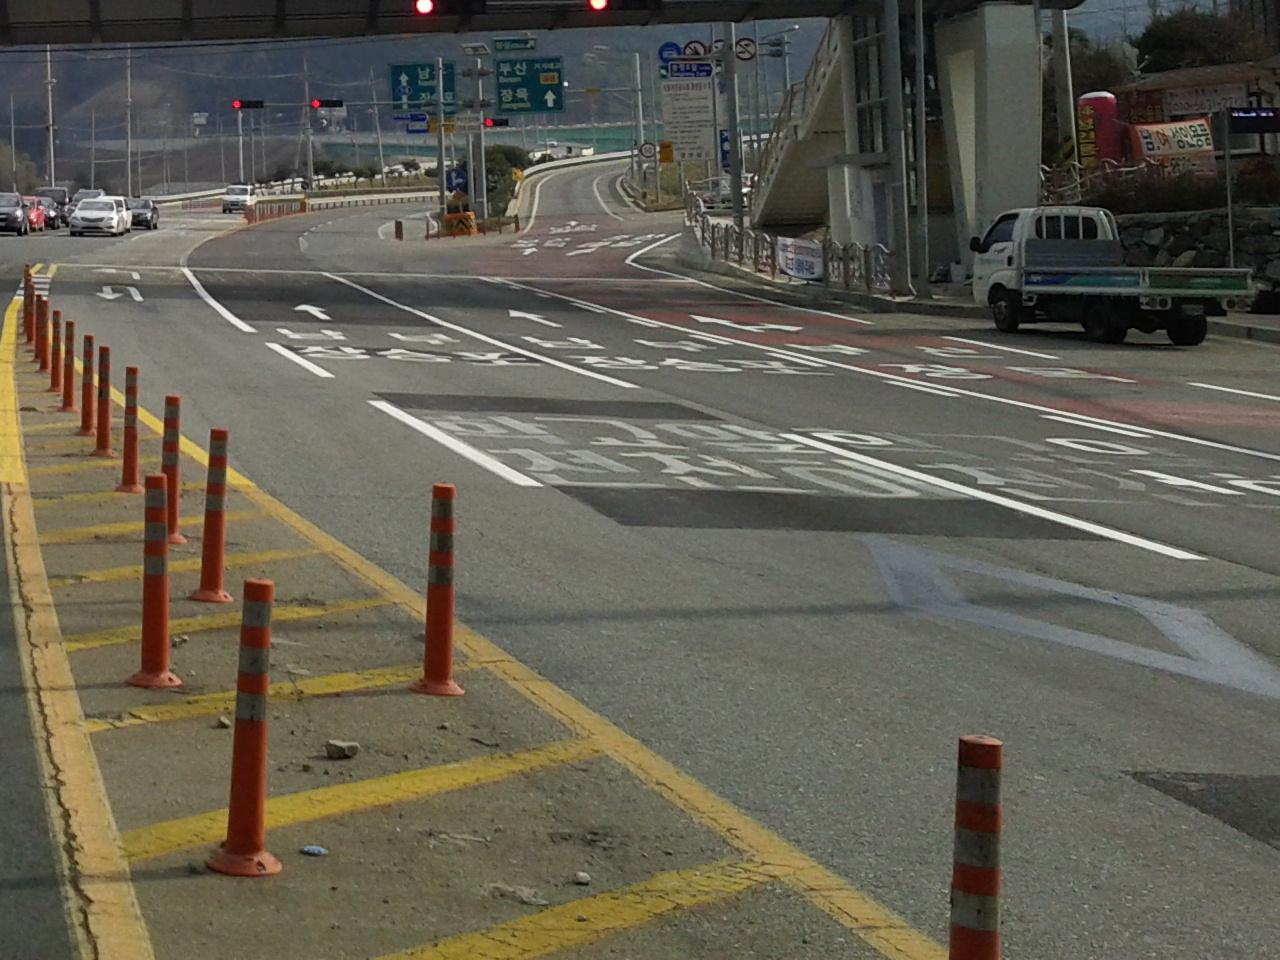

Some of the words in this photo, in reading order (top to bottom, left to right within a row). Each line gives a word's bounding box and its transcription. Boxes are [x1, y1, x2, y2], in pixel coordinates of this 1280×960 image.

[500, 62, 527, 76] 부산
[501, 88, 529, 102] 장목
[1171, 122, 1212, 150] 성인용품
